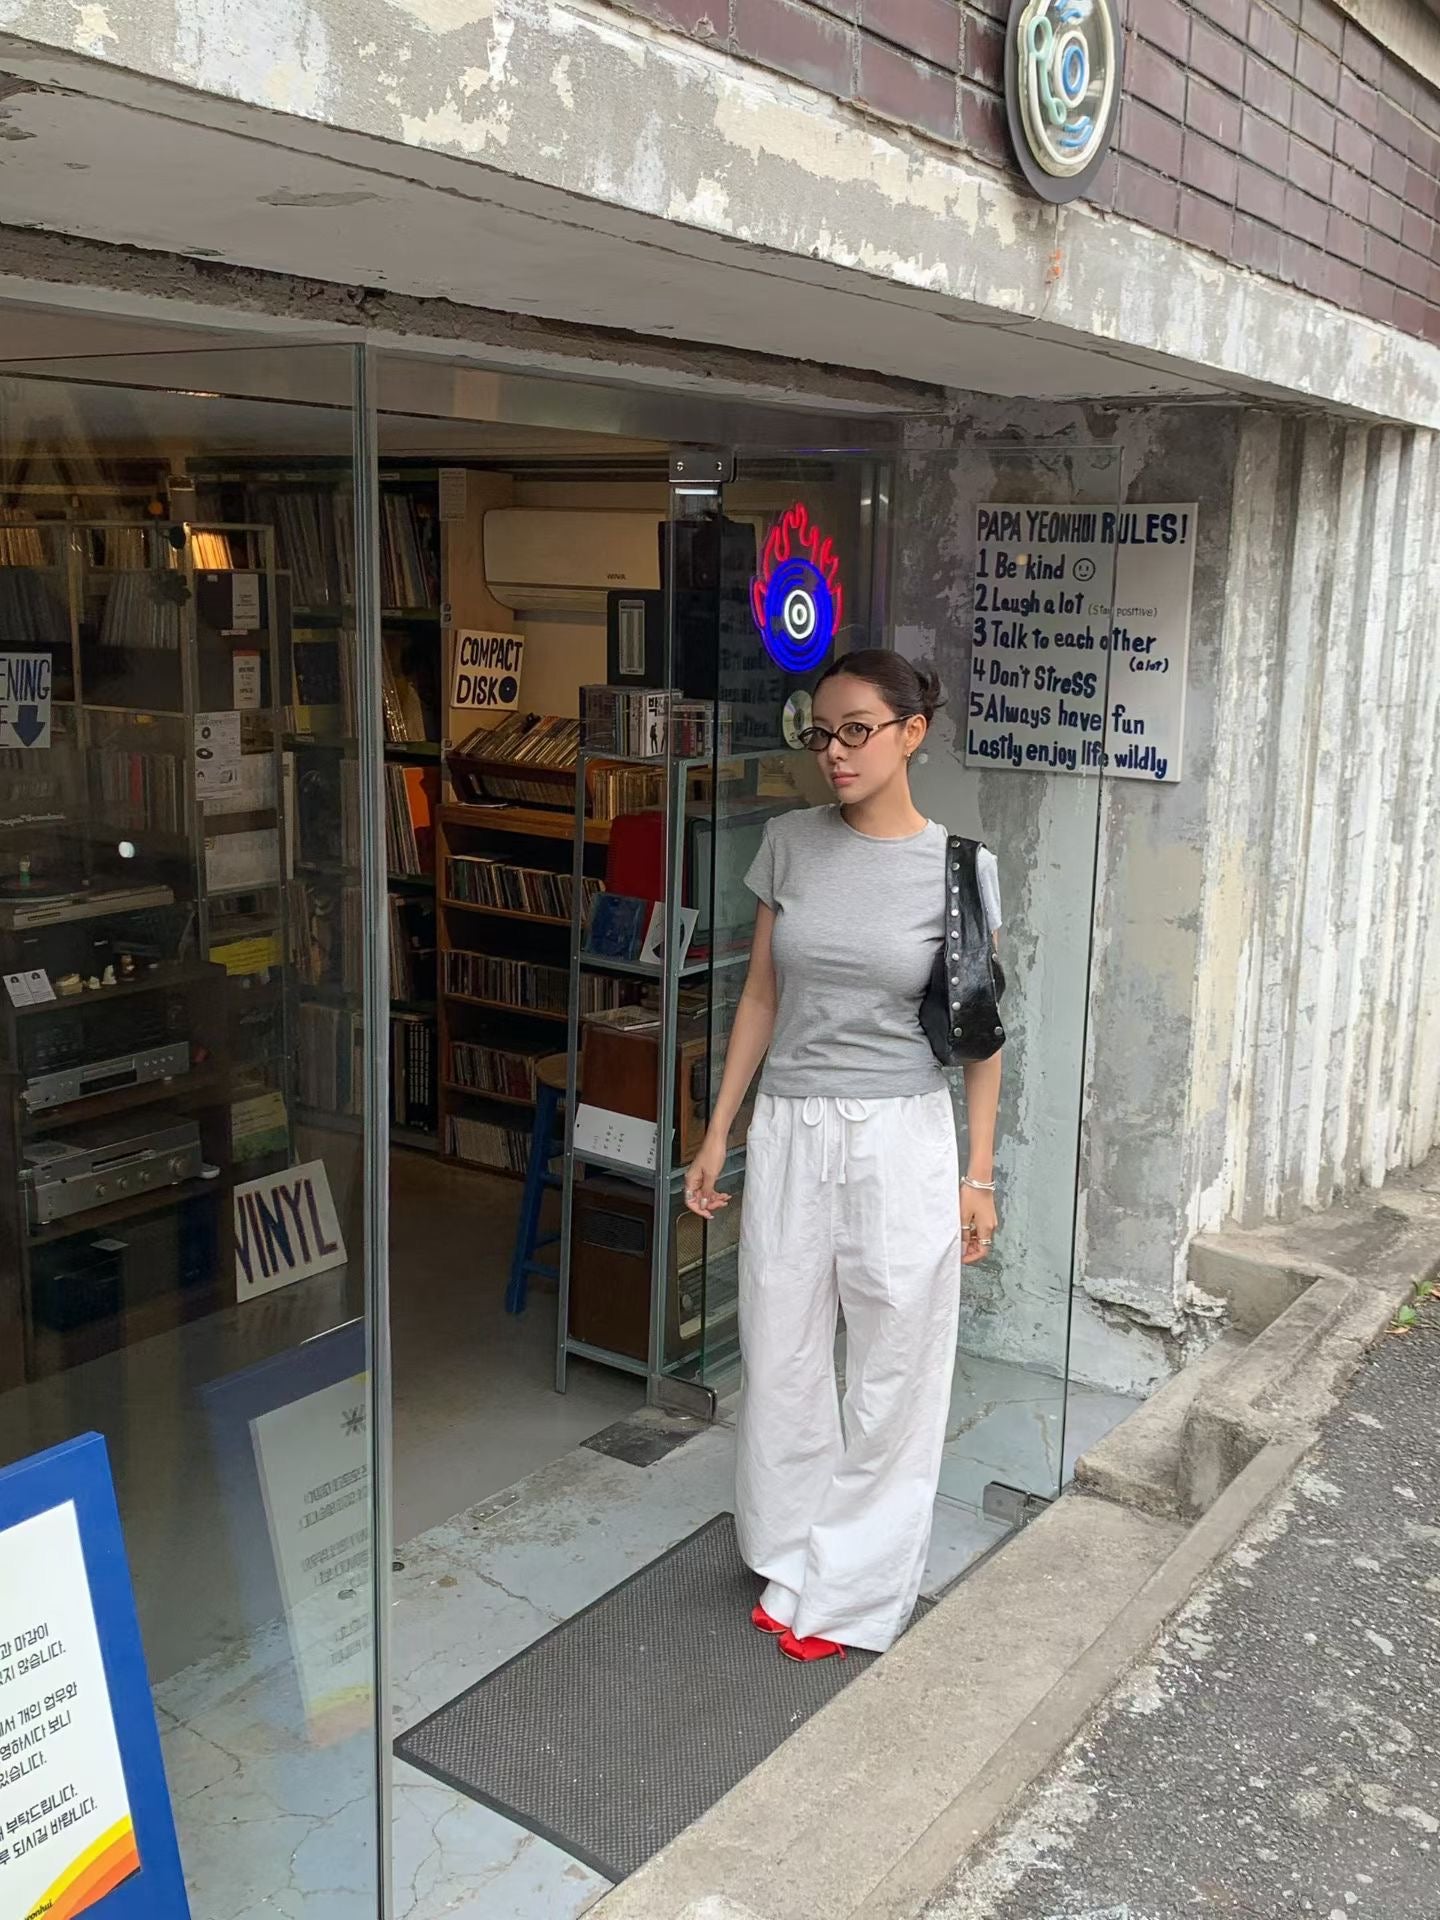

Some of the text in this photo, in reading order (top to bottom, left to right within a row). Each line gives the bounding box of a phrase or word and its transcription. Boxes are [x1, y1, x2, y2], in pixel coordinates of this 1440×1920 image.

[977, 509, 1188, 545] PAPA YEONHUI RULES!
[976, 548, 1065, 580] 1 Be kind
[975, 583, 989, 612] 2
[992, 587, 1040, 617] Laugh
[1044, 598, 1055, 614] a
[1059, 592, 1085, 615] lot
[973, 617, 1157, 654] 3 Talk to each other
[460, 636, 523, 672] COMPACT
[456, 674, 499, 705] DISK
[973, 657, 986, 681] 4
[989, 659, 1030, 689] Don't
[969, 691, 1145, 735] 5 Always have fun
[968, 730, 1168, 779] Lastly enjoy life wildly
[235, 1178, 338, 1284] VINYL
[14, 1622, 49, 1652] 마감이
[17, 1640, 66, 1675] 않습니다.
[17, 1701, 41, 1725] 개인
[44, 1681, 78, 1711] 업무와
[48, 1709, 71, 1735] 보니
[6, 1783, 78, 1834] 부탁드립니다.
[12, 1825, 48, 1859] 되시길
[50, 1796, 98, 1835] 바랍니다.
